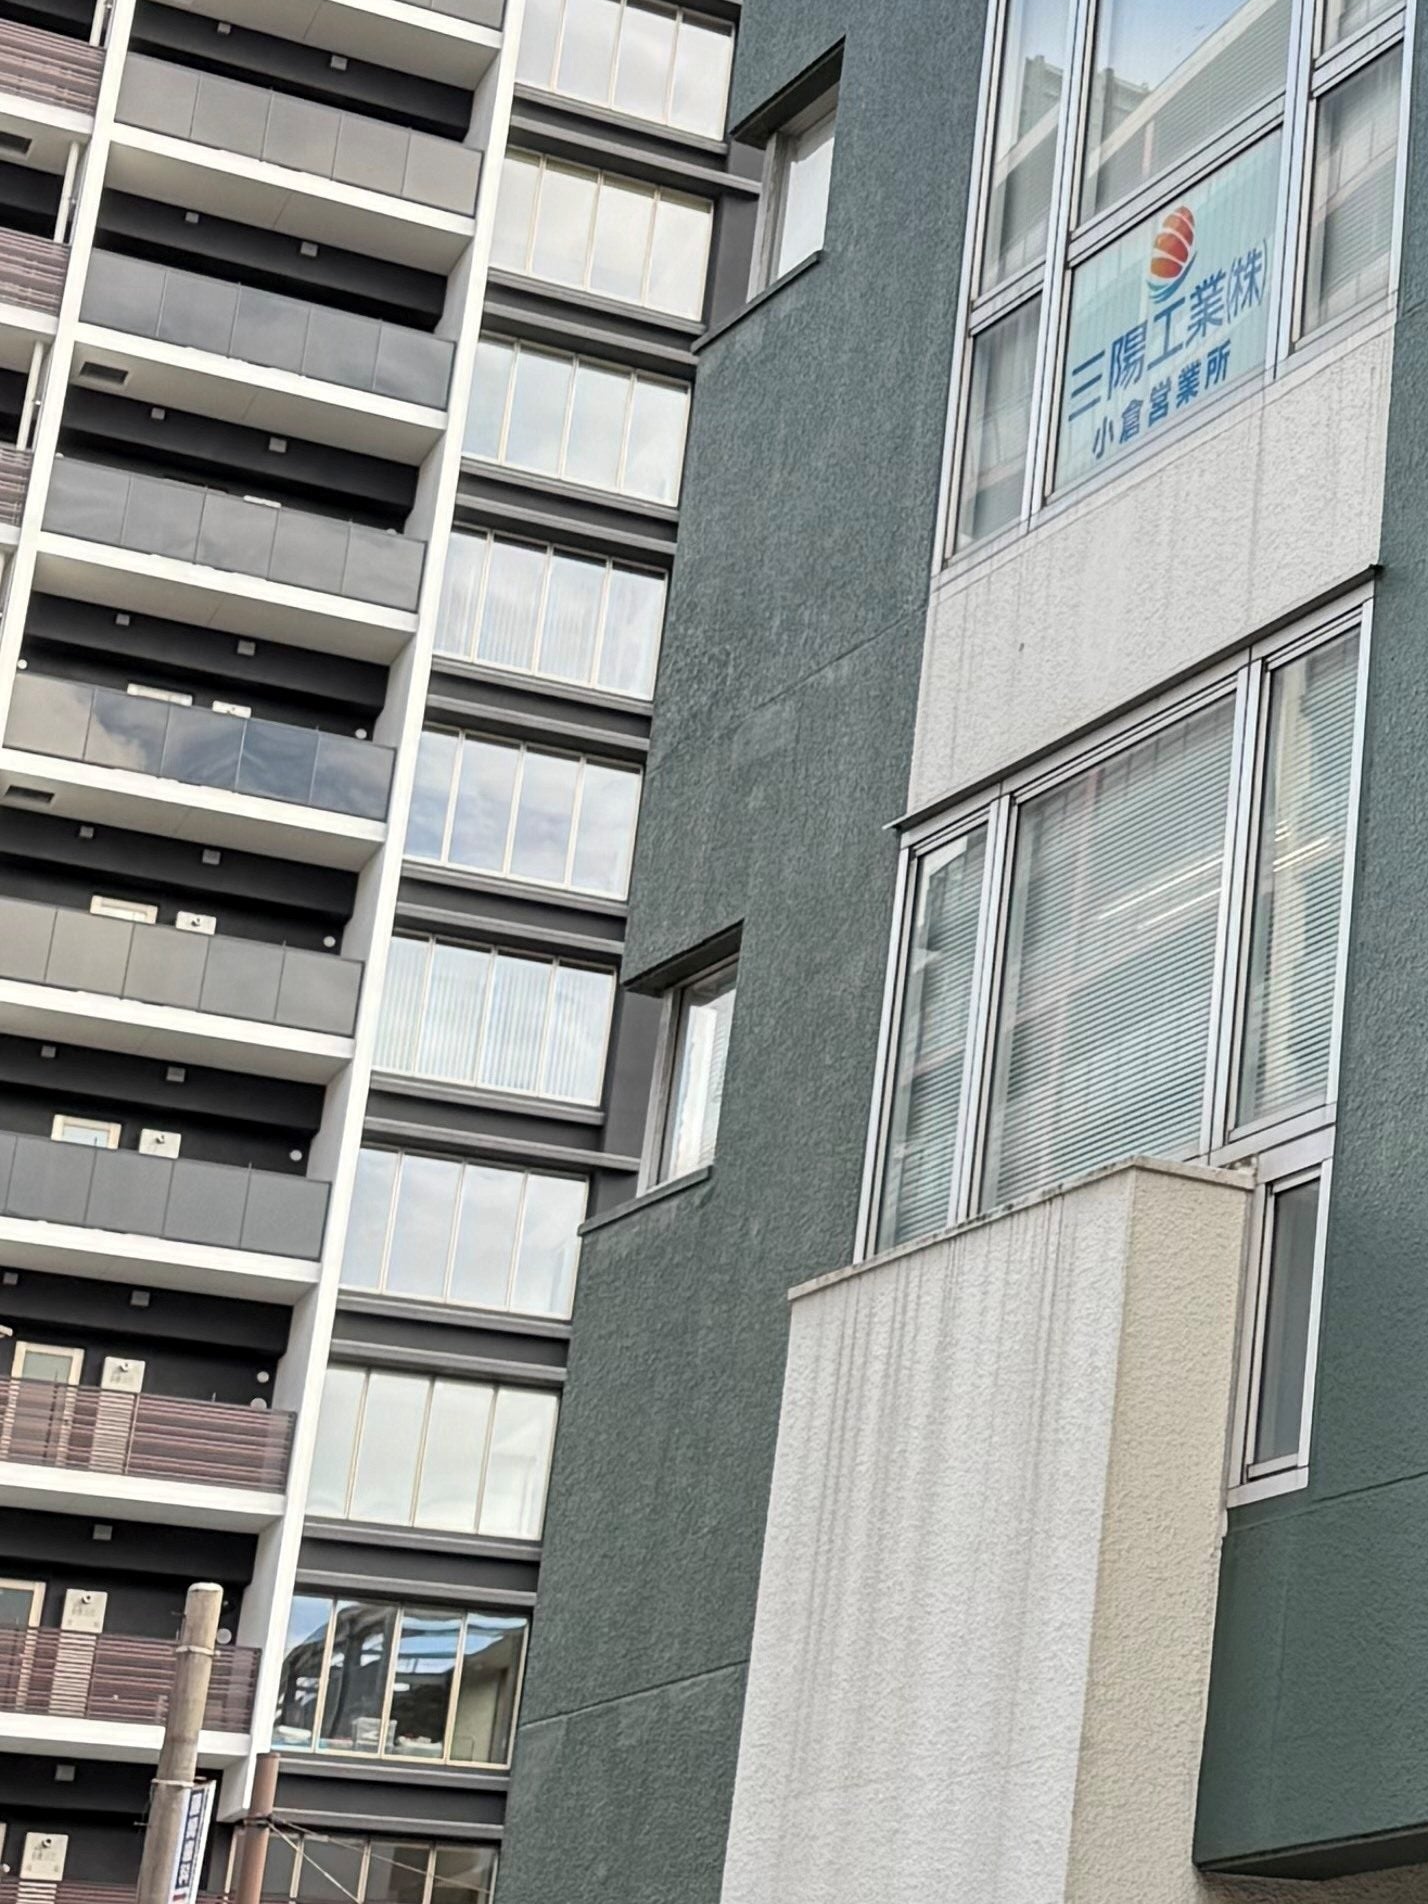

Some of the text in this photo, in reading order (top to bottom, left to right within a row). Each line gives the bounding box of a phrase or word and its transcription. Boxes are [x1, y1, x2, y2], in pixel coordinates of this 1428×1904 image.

[1068, 239, 1267, 422] 三陽工業(株)
[1092, 339, 1231, 460] 小倉営業所
